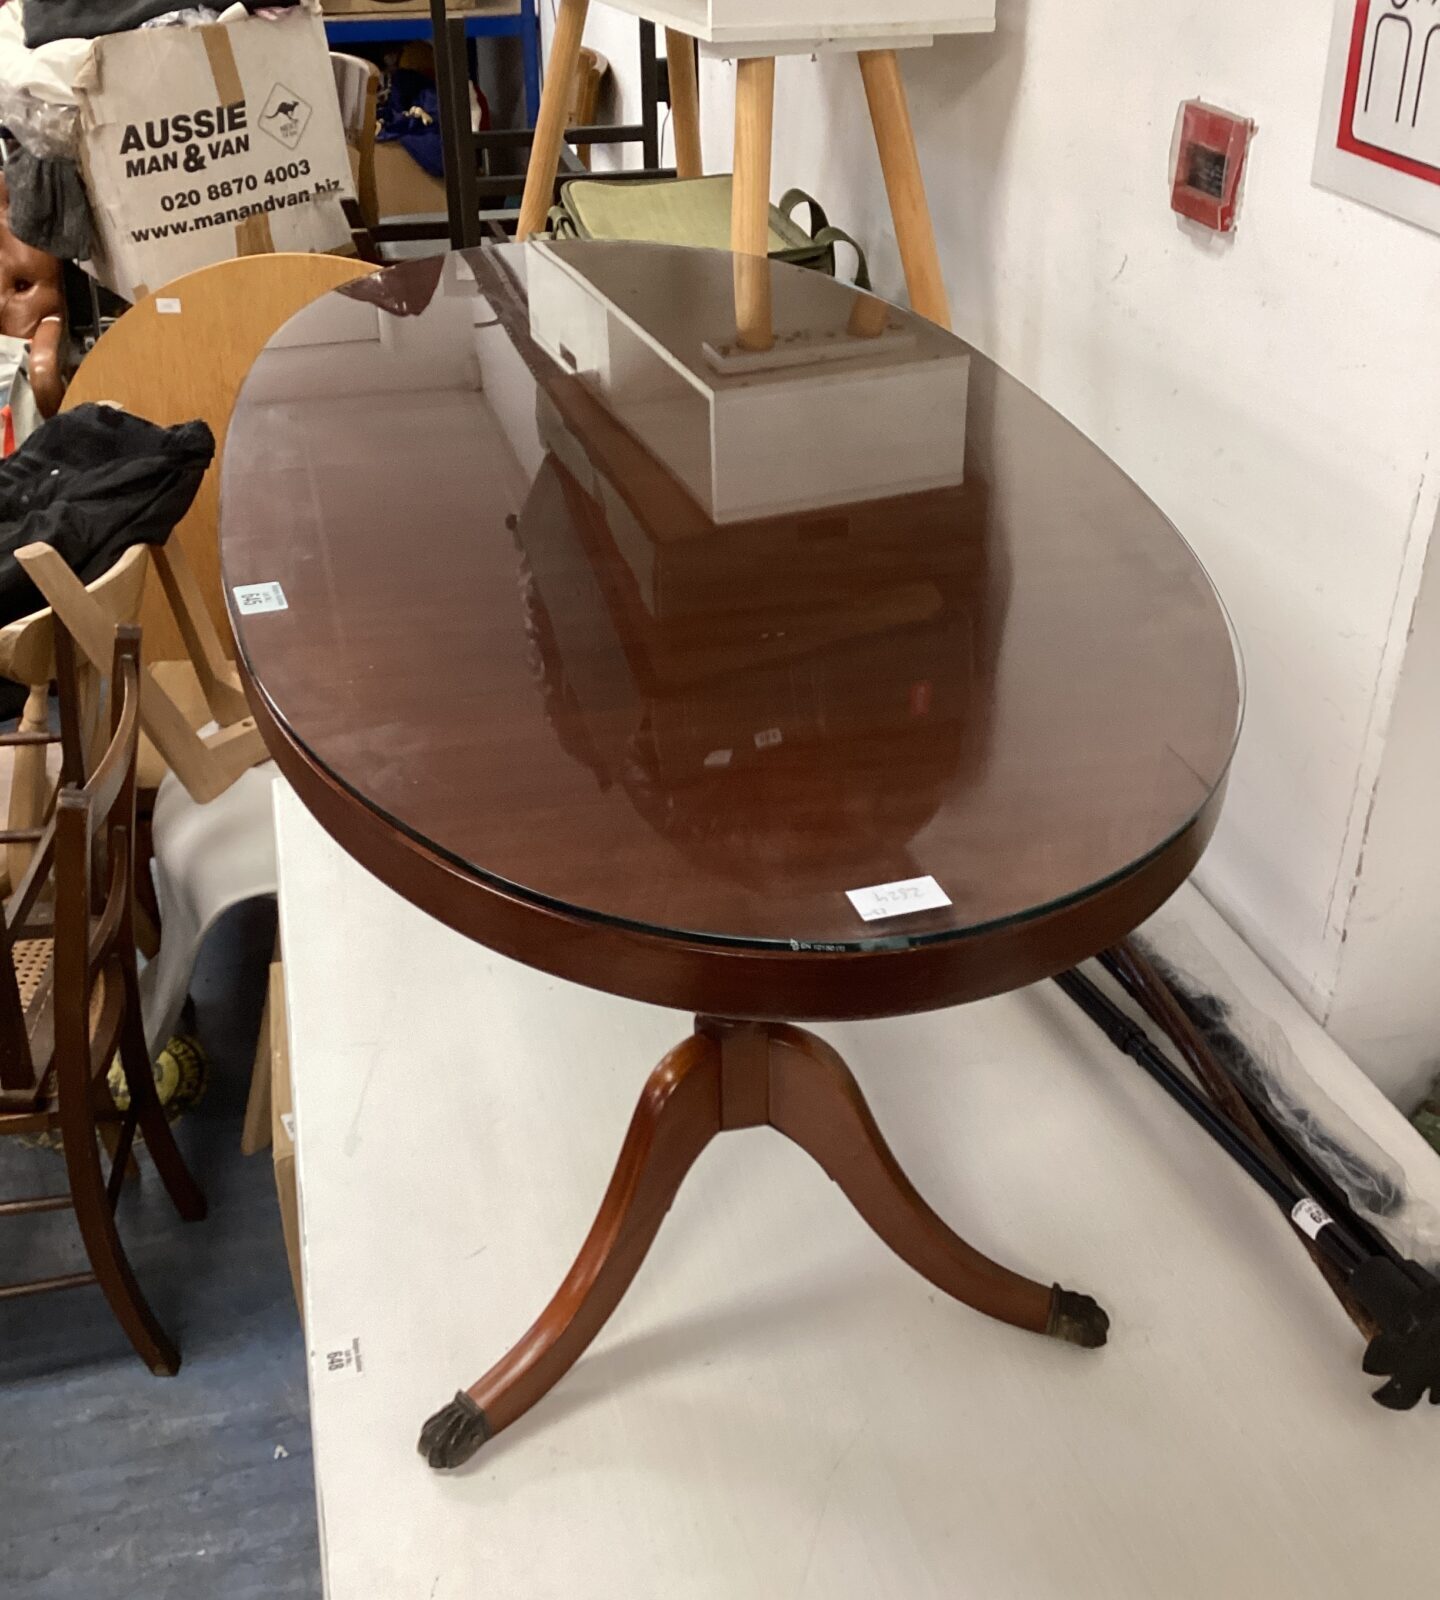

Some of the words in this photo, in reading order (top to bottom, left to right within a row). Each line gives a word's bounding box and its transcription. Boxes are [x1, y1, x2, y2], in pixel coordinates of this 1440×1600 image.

[120, 101, 248, 155] AUSSIE
[126, 151, 178, 178] MAN
[183, 143, 206, 173] &
[207, 134, 250, 160] VAN
[131, 178, 341, 243] www.manandvanbiz
[160, 189, 201, 212] 020
[207, 175, 259, 201] 8870
[263, 159, 311, 186] 4003
[326, 1350, 344, 1371] 648
